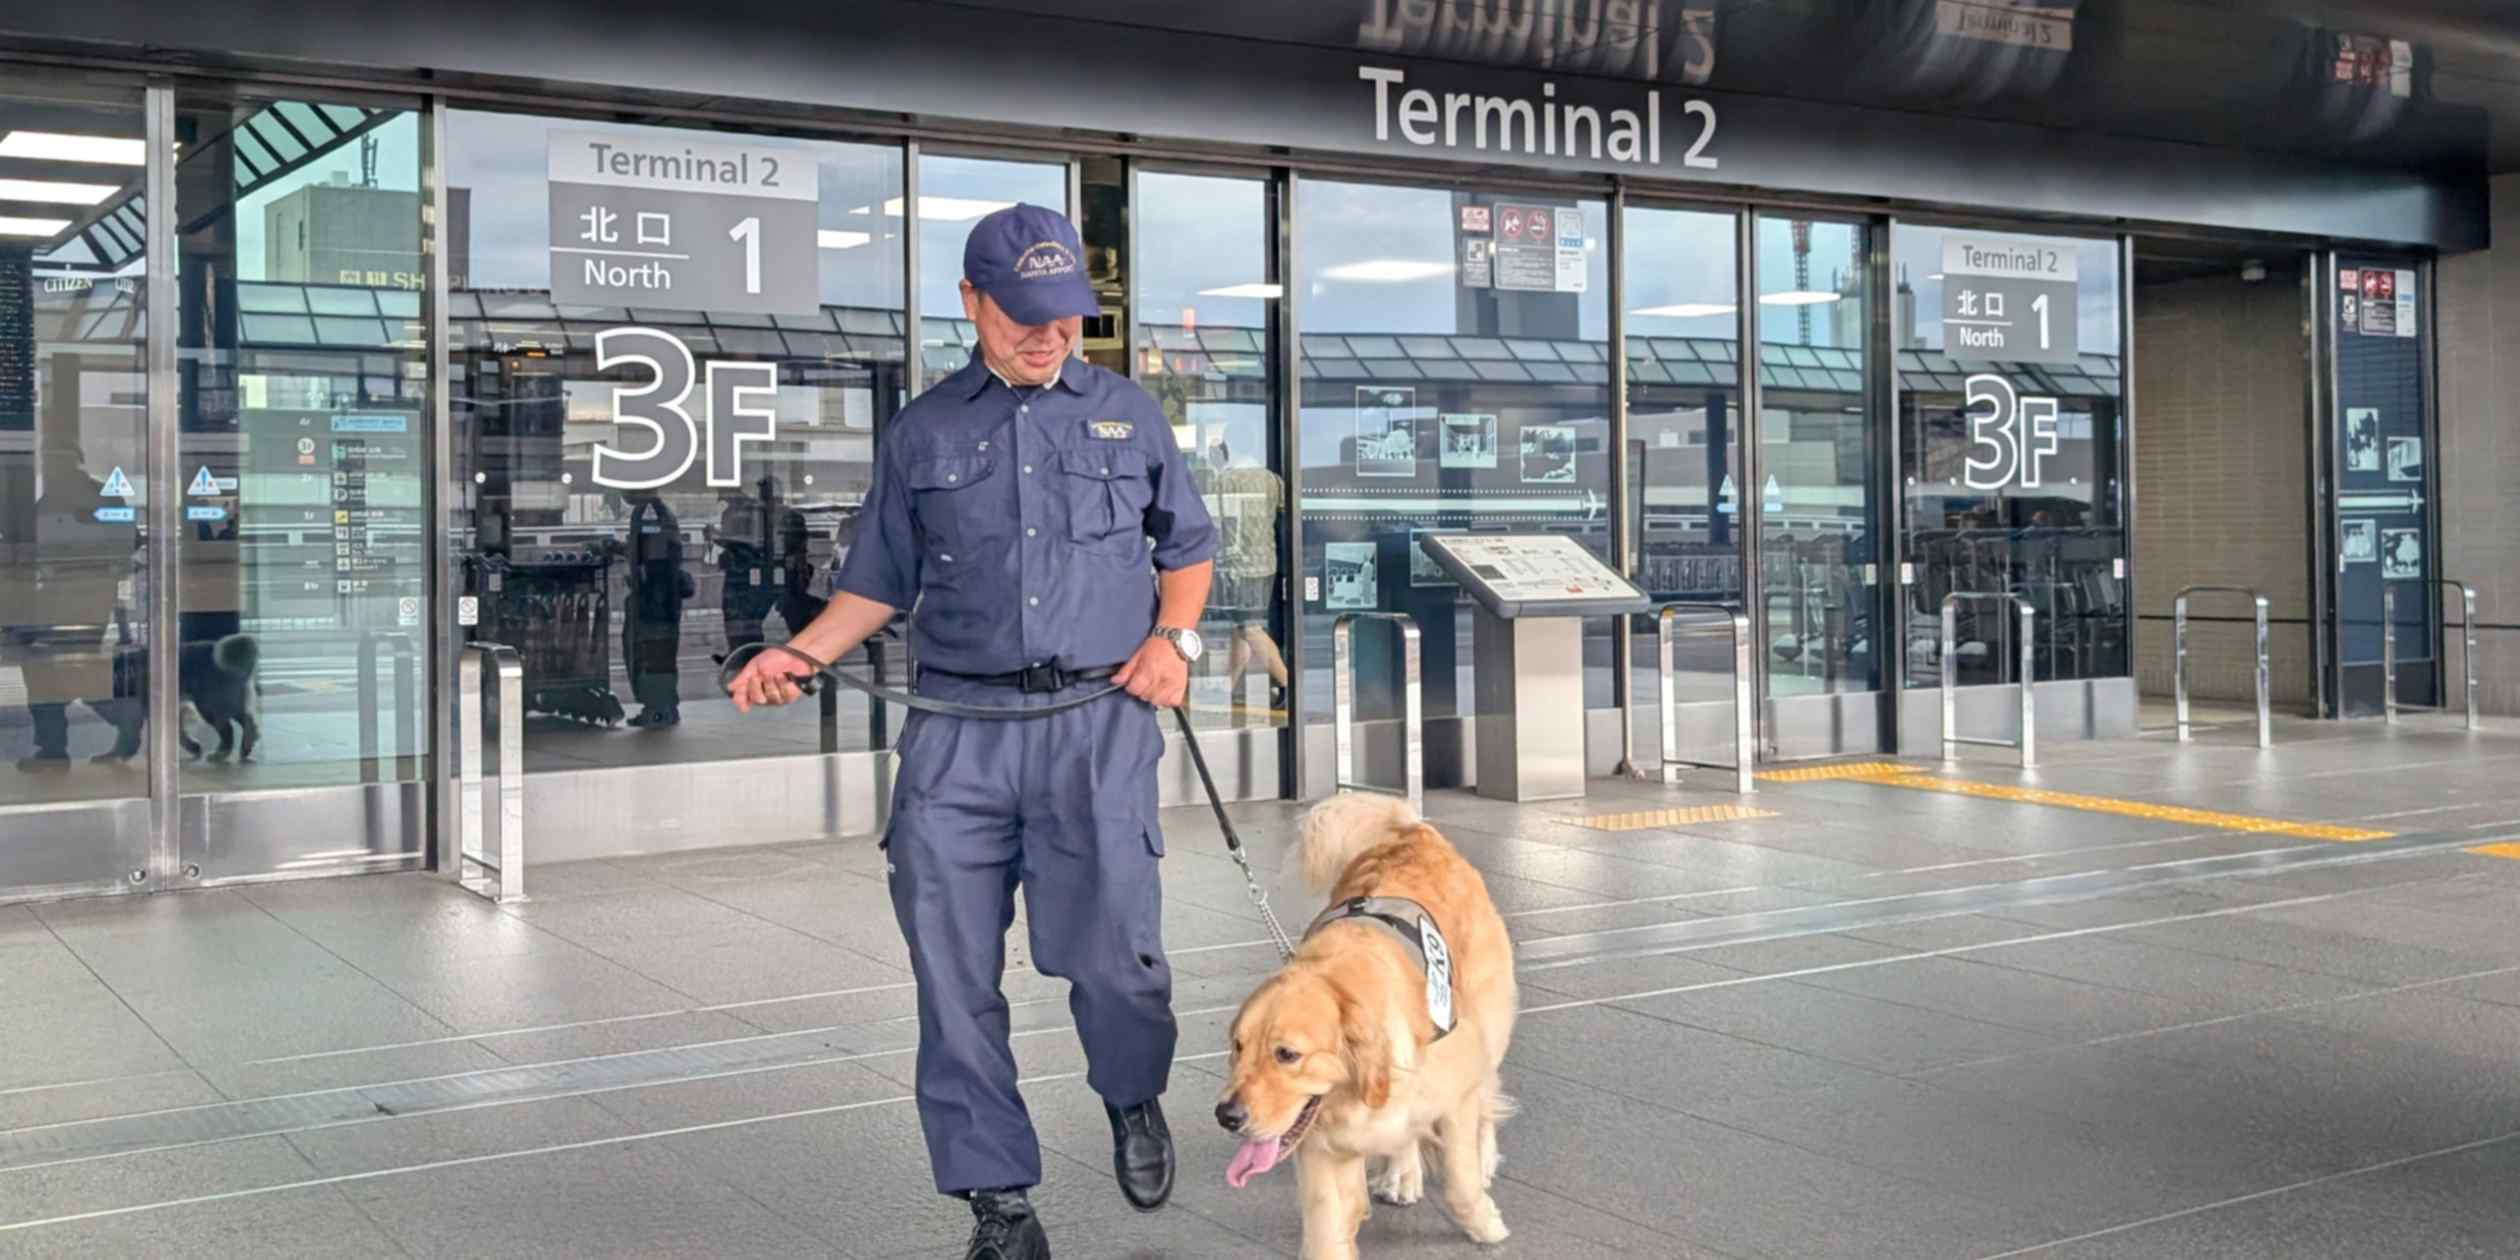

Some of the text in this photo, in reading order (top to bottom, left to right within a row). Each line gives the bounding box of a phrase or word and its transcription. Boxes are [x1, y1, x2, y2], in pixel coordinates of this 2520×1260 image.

[1358, 66, 1719, 169] Terminal 2
[589, 142, 780, 188] Terminal 2
[580, 205, 671, 246] 北口
[584, 259, 671, 289] North
[728, 217, 761, 294] 1
[1962, 245, 2058, 273] Terminal 2
[1957, 289, 2004, 317] 北口
[2031, 293, 2050, 350] 1
[1959, 326, 2004, 348] North
[591, 326, 778, 490] 3F
[1964, 373, 2059, 490] 3F
